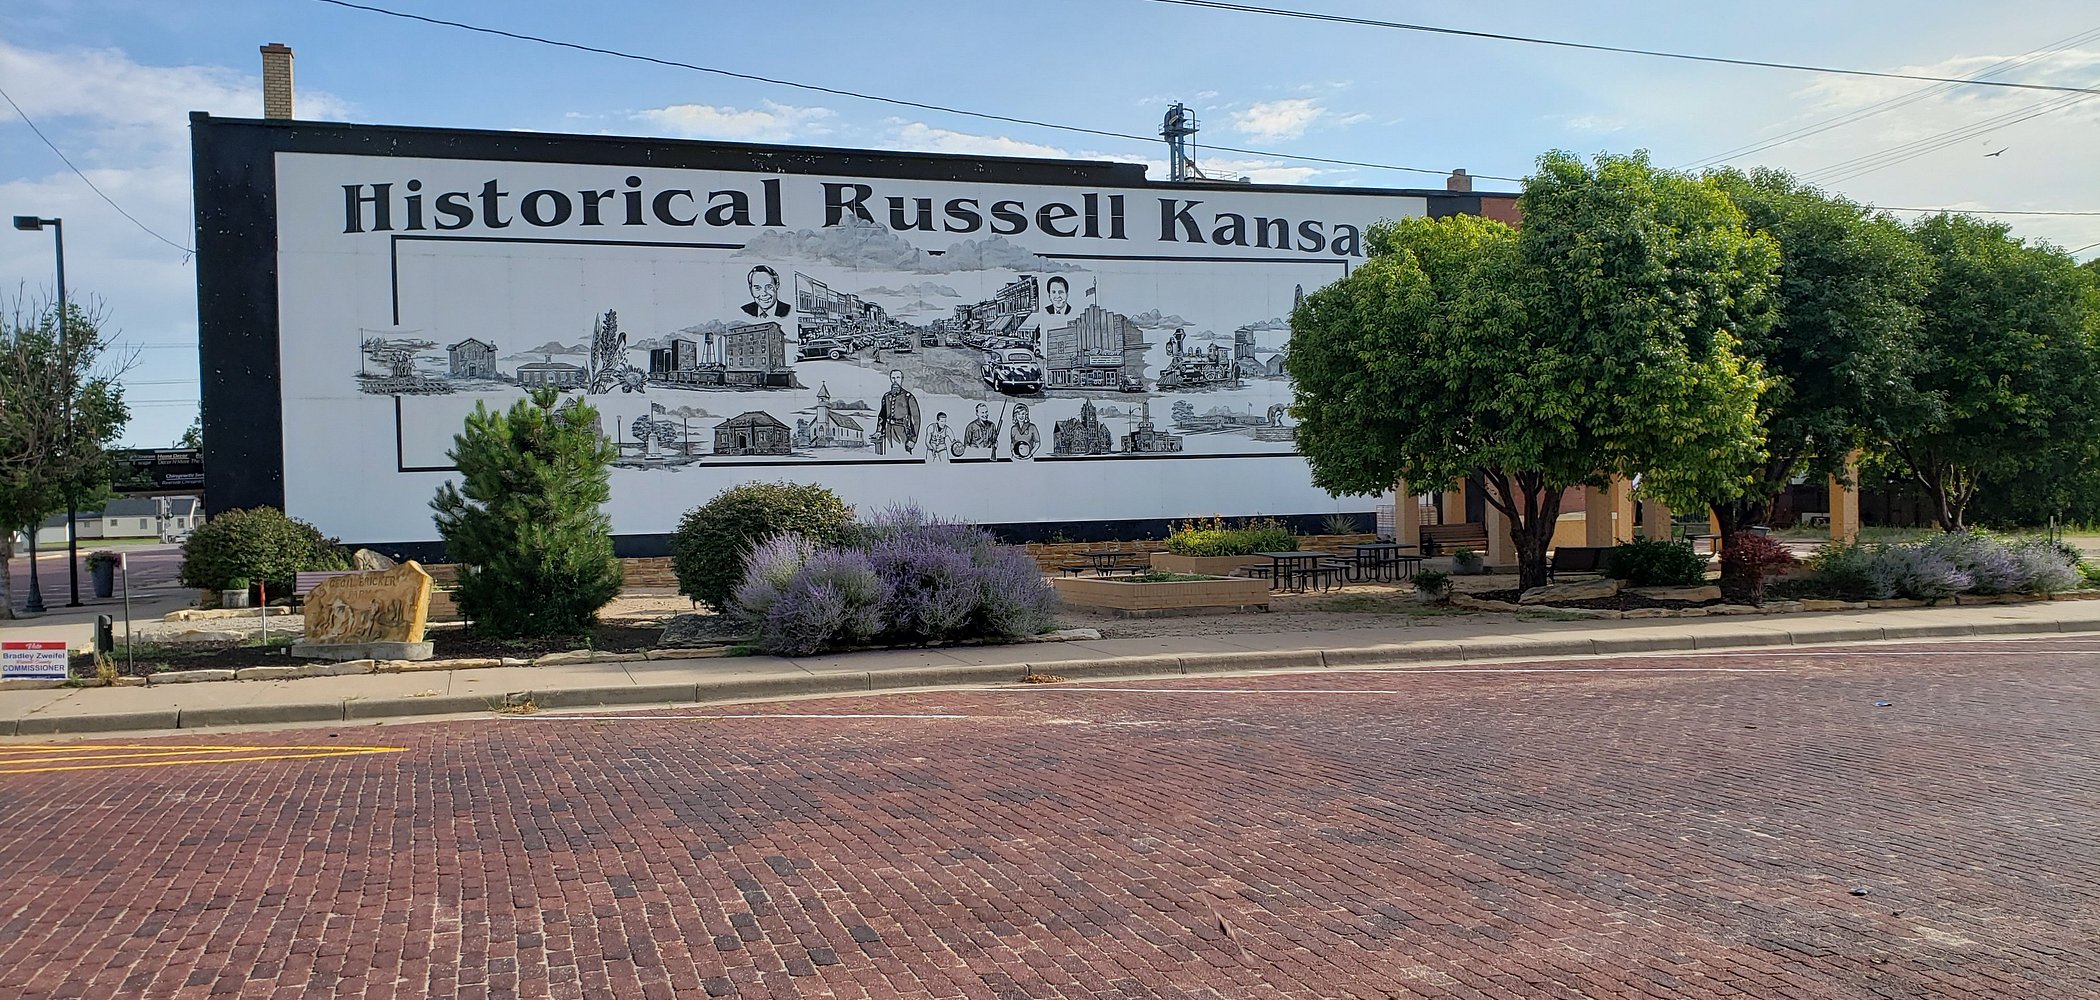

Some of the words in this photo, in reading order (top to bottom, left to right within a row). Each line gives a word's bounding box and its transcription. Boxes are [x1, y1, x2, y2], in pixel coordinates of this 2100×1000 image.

[341, 175, 787, 234] Historical
[821, 182, 1128, 240] Russell
[1158, 197, 1364, 258] Kansa
[359, 575, 397, 587] BRICKER
